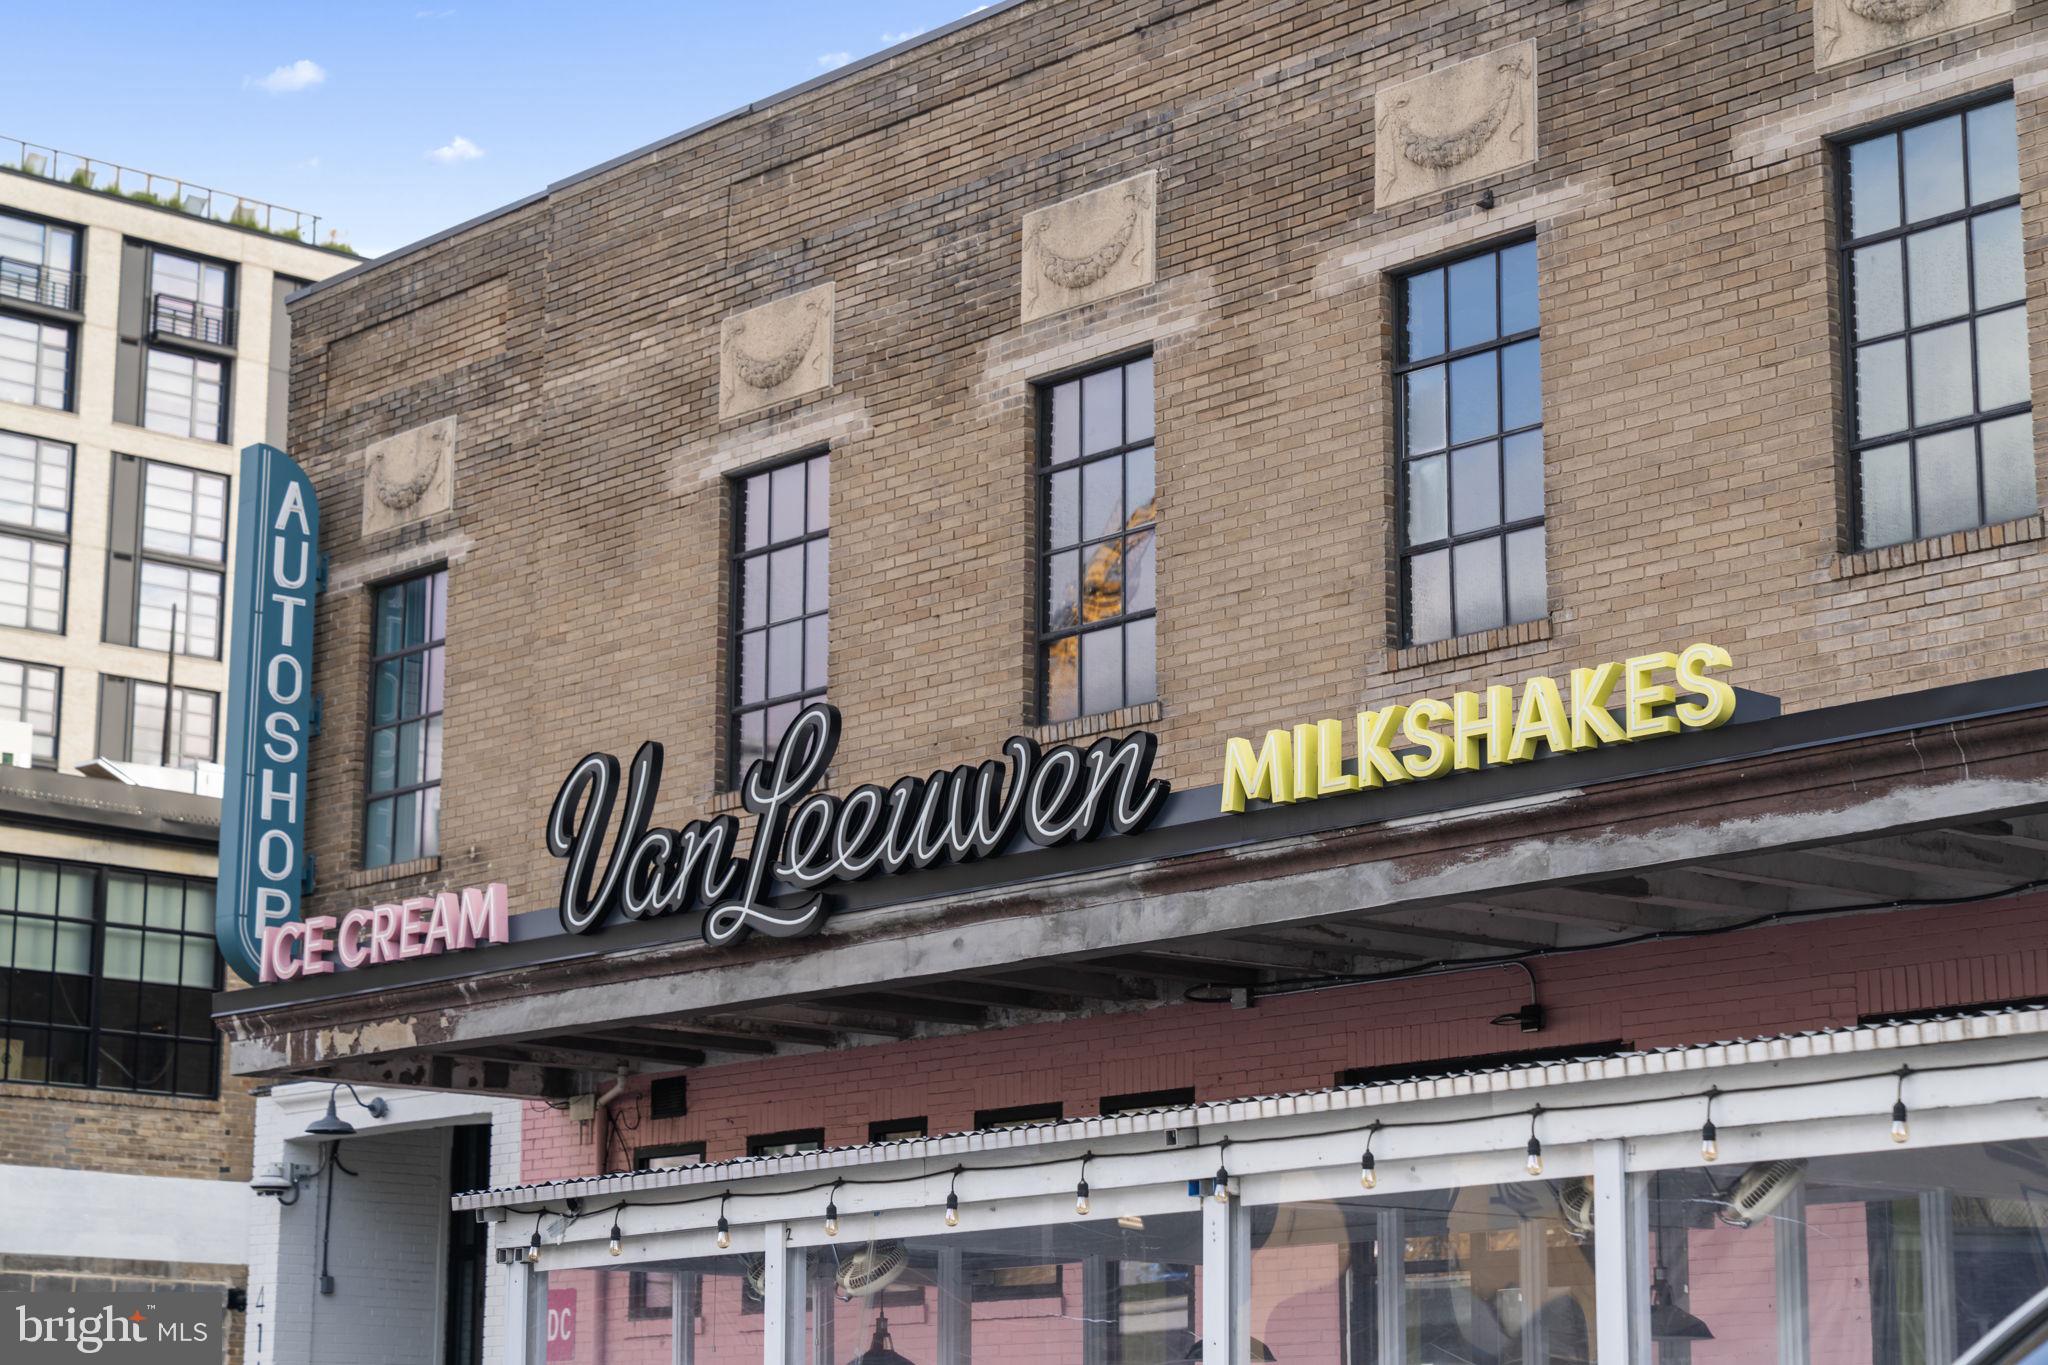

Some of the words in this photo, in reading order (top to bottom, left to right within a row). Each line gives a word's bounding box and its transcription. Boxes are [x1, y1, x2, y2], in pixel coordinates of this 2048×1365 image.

[1220, 642, 1736, 813] MILKSHAKES
[545, 740, 747, 935] Van
[701, 703, 1171, 946] Leeuwen
[259, 916, 337, 983] ICE
[338, 883, 509, 968] CREAM
[255, 1285, 265, 1365] 41
[547, 1307, 571, 1342] DC
